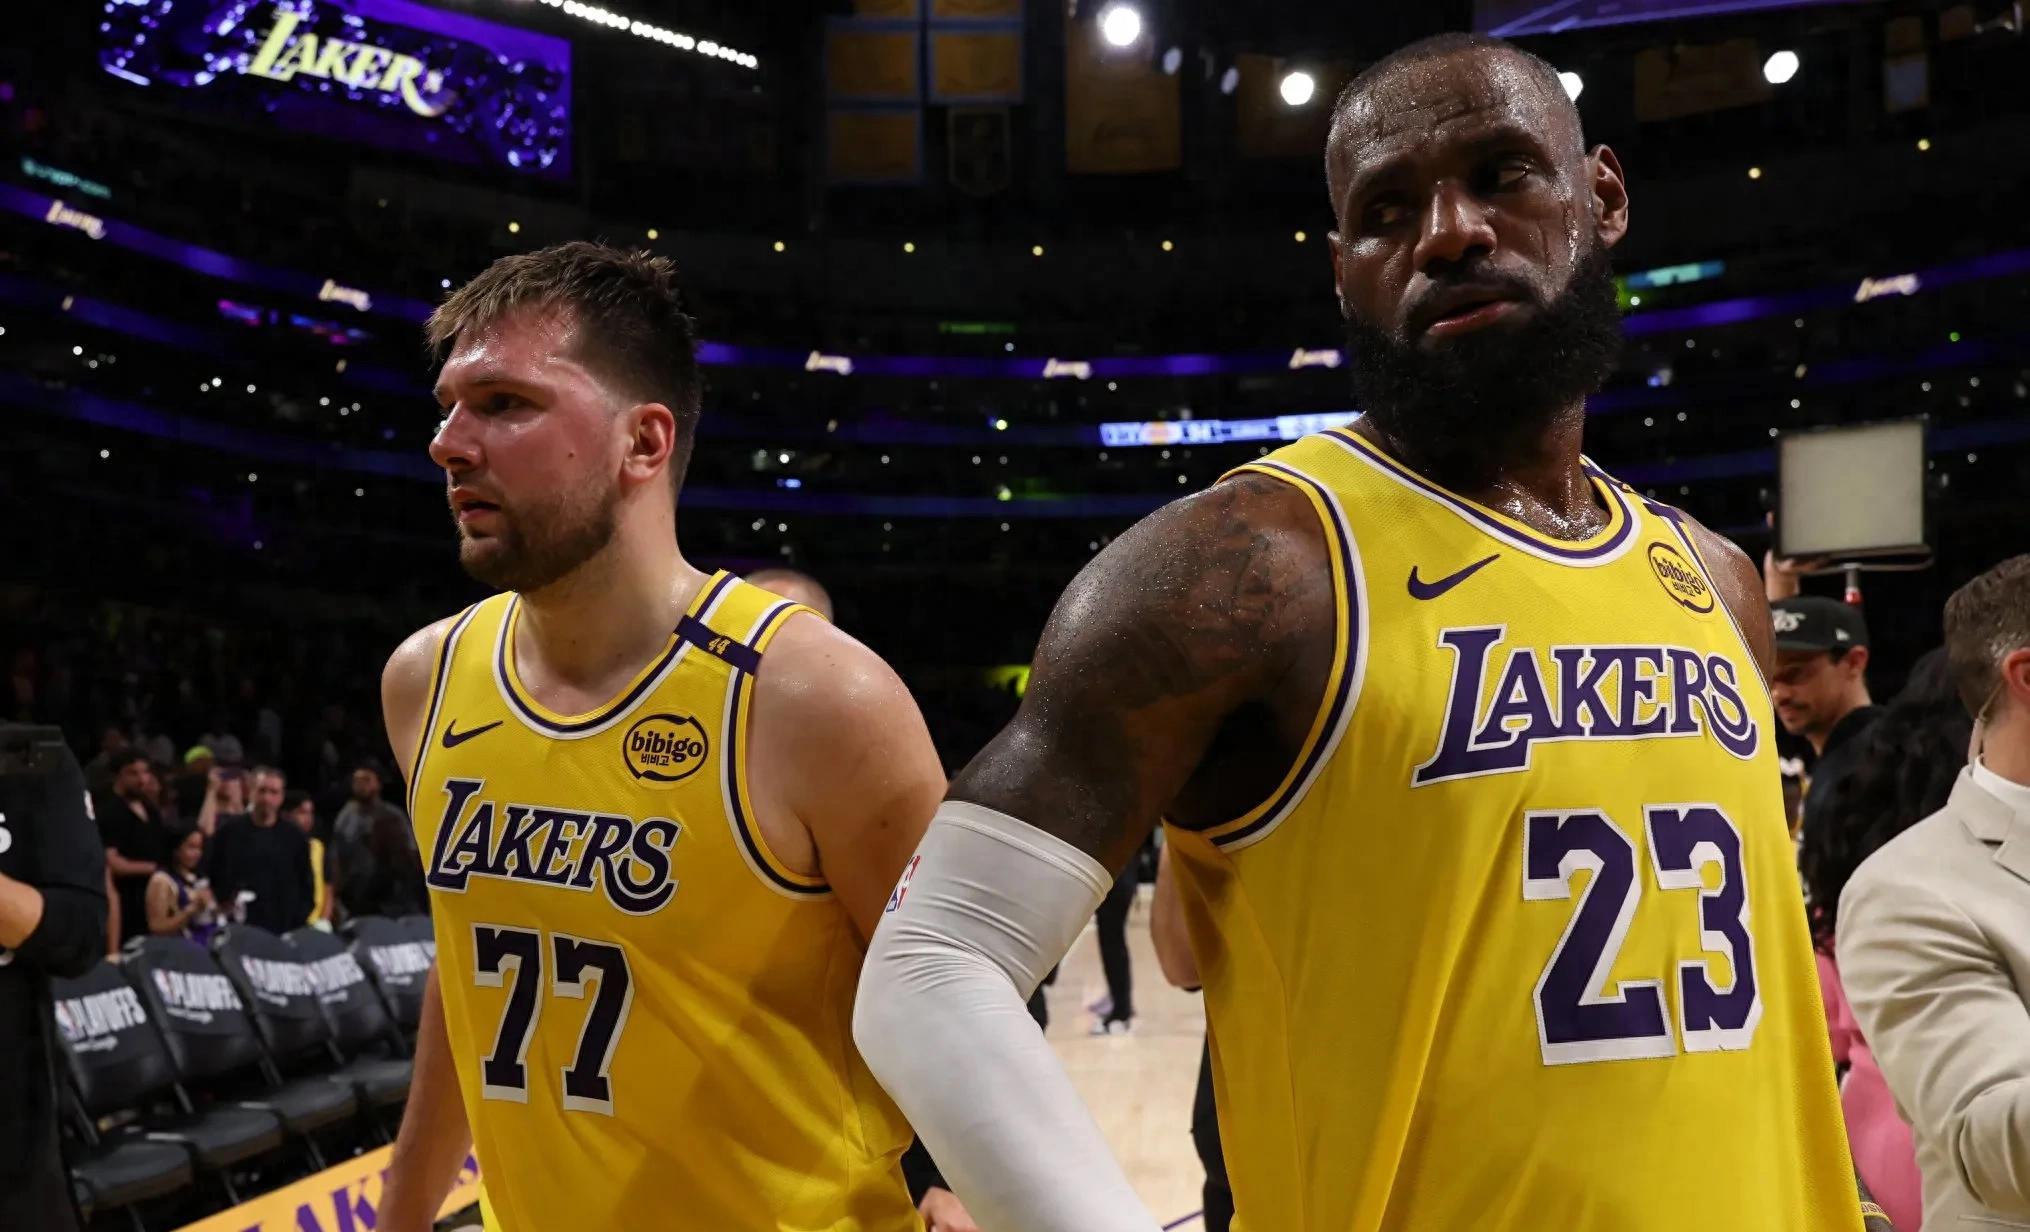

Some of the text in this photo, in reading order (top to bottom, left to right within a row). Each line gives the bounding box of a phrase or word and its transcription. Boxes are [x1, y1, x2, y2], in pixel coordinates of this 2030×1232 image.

[1652, 556, 1706, 595] bibigo
[708, 637, 731, 655] 44
[631, 730, 703, 763] bibigo
[1410, 624, 1760, 788] LAKERS
[640, 753, 670, 766] 비비고
[426, 778, 683, 916] LAKERS
[1523, 803, 1762, 1066] 23
[471, 922, 635, 1116] 77
